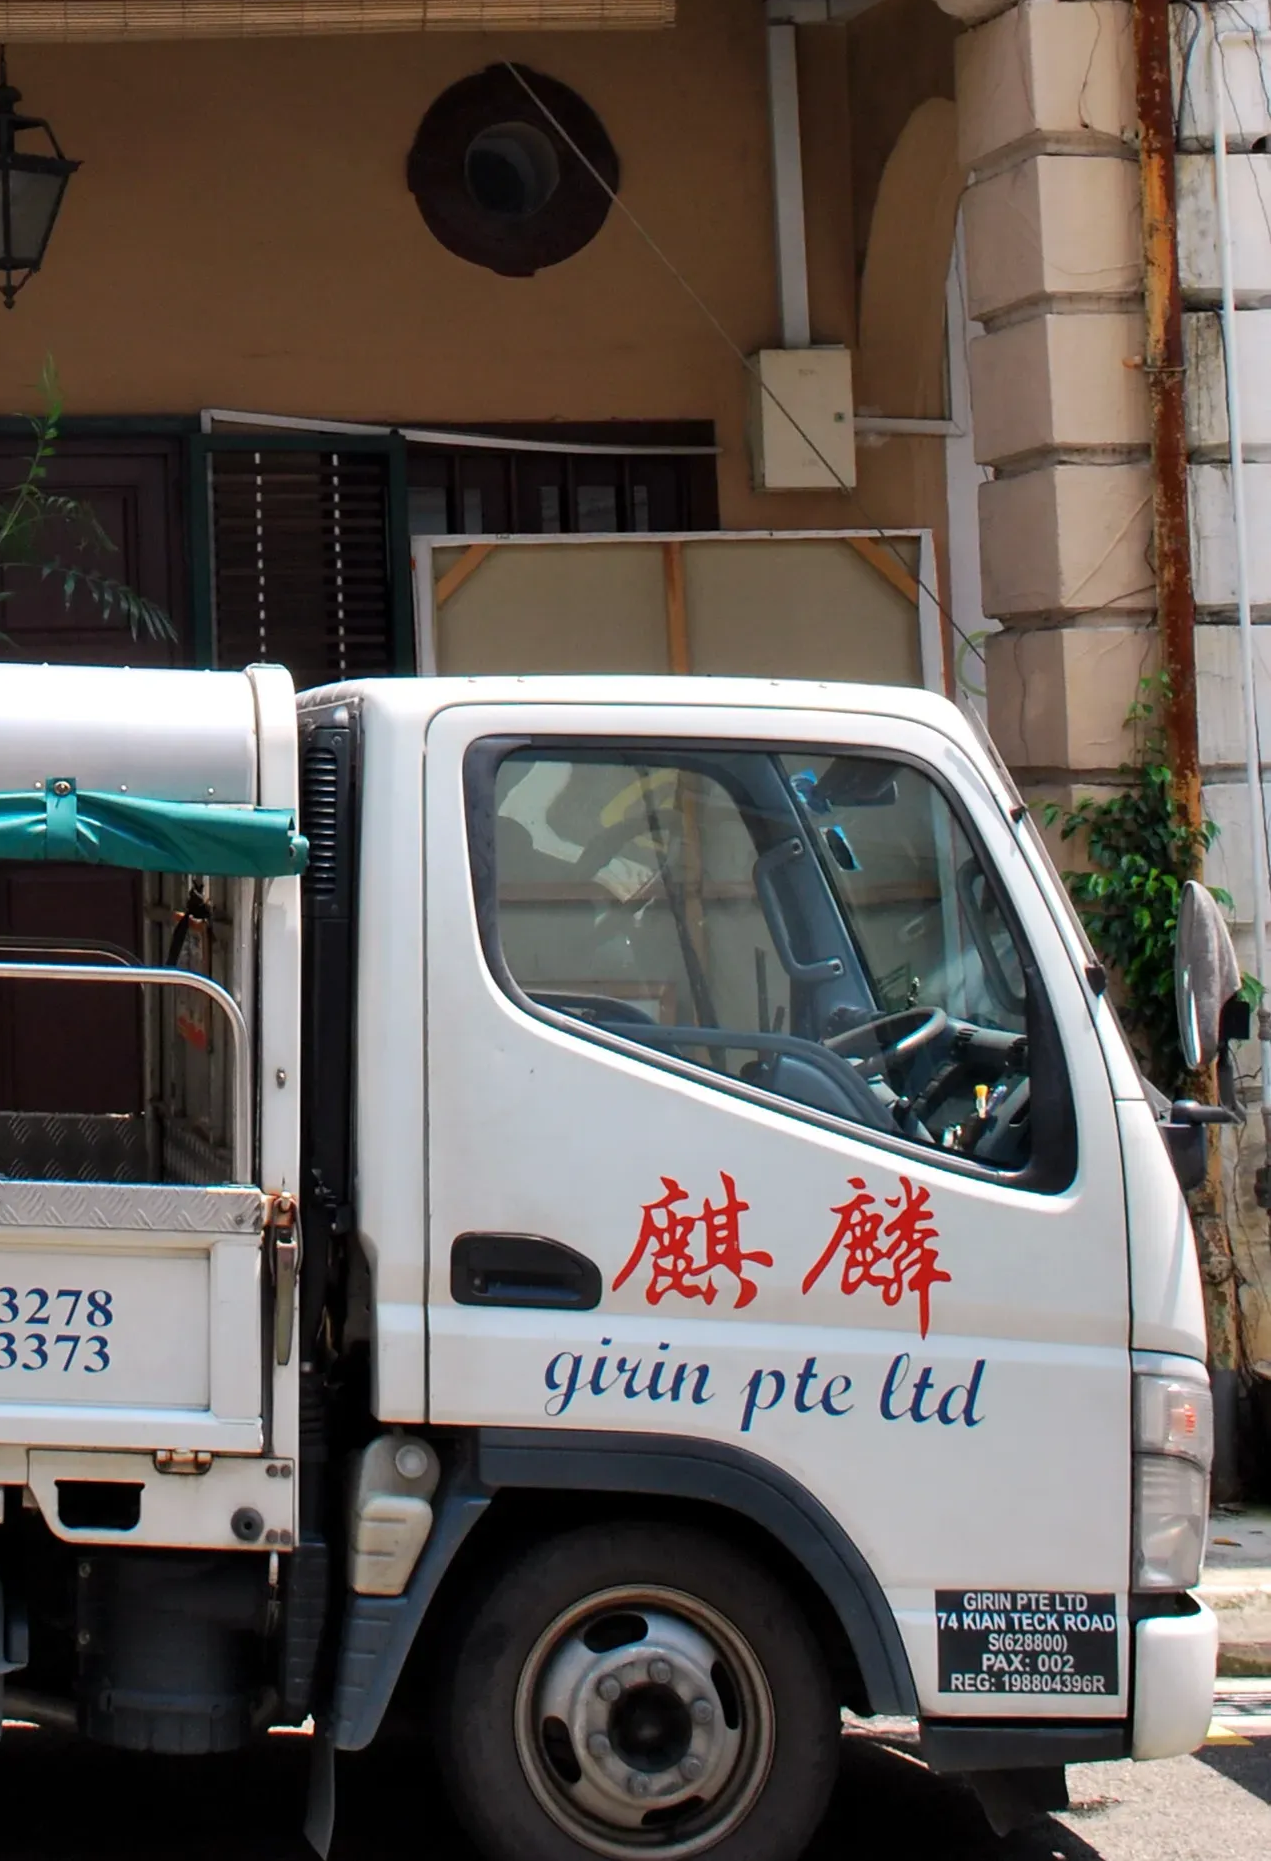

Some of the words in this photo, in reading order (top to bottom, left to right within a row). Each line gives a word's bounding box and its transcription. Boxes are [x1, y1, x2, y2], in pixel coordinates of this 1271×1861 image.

[544, 1337, 715, 1417] girin
[739, 1356, 855, 1433] pte
[879, 1352, 987, 1428] ltd
[963, 1592, 1012, 1610] GIRIN
[1017, 1593, 1050, 1611] PTE
[1055, 1594, 1088, 1612] LTD
[937, 1612, 958, 1630] 74
[963, 1613, 1006, 1630] KIAN
[1010, 1613, 1060, 1631] TECK
[1064, 1614, 1116, 1632] ROAD
[988, 1633, 1068, 1652] S(628800)
[981, 1654, 1030, 1672] PAX:
[1037, 1655, 1074, 1673] 002
[951, 1673, 996, 1691] REG:
[1002, 1675, 1106, 1693] 198804396R
